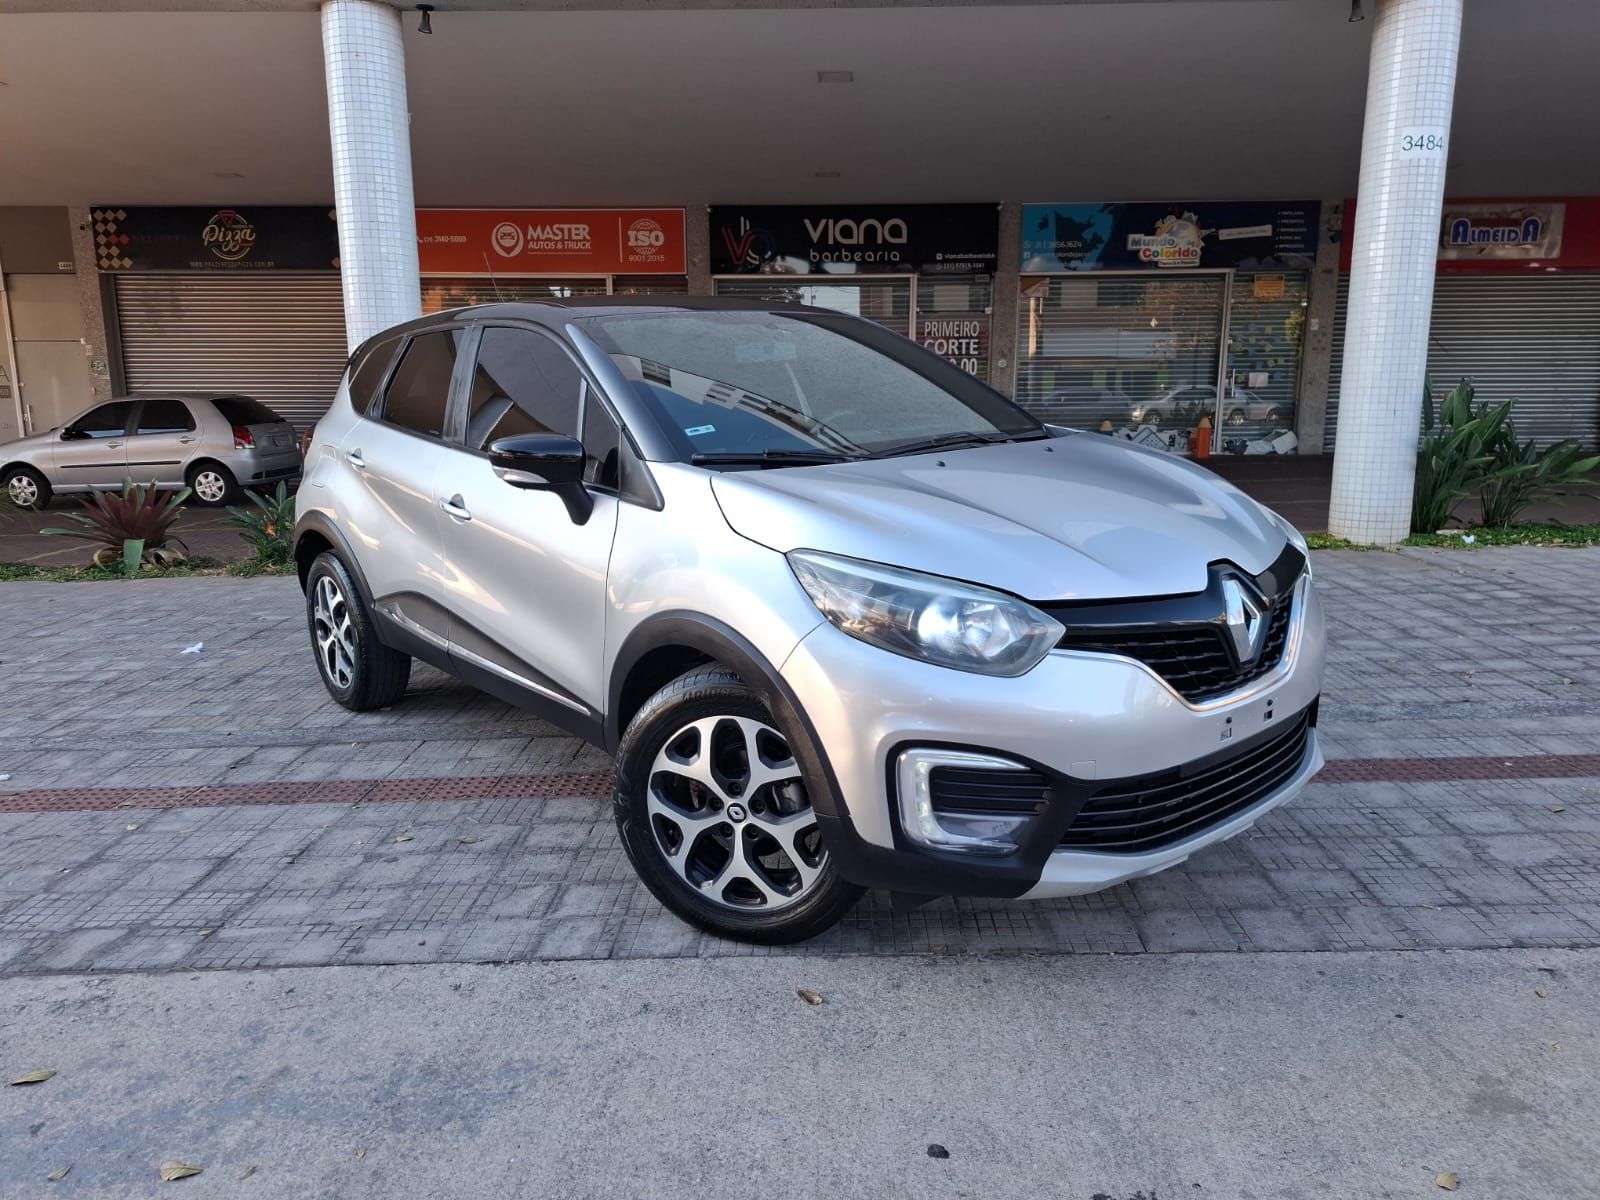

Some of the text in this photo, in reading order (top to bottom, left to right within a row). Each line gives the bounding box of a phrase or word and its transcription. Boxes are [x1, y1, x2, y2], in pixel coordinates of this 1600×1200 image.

[1402, 134, 1443, 151] 3484
[202, 224, 256, 251] Pizza
[528, 224, 591, 240] MASTER
[628, 230, 665, 246] ISO
[528, 241, 592, 249] AUTOS & TRUCK
[1131, 237, 1176, 248] Mundo
[810, 249, 900, 262] barbearia
[1143, 247, 1198, 259] Colorido
[924, 321, 979, 337] PRIMEIRO
